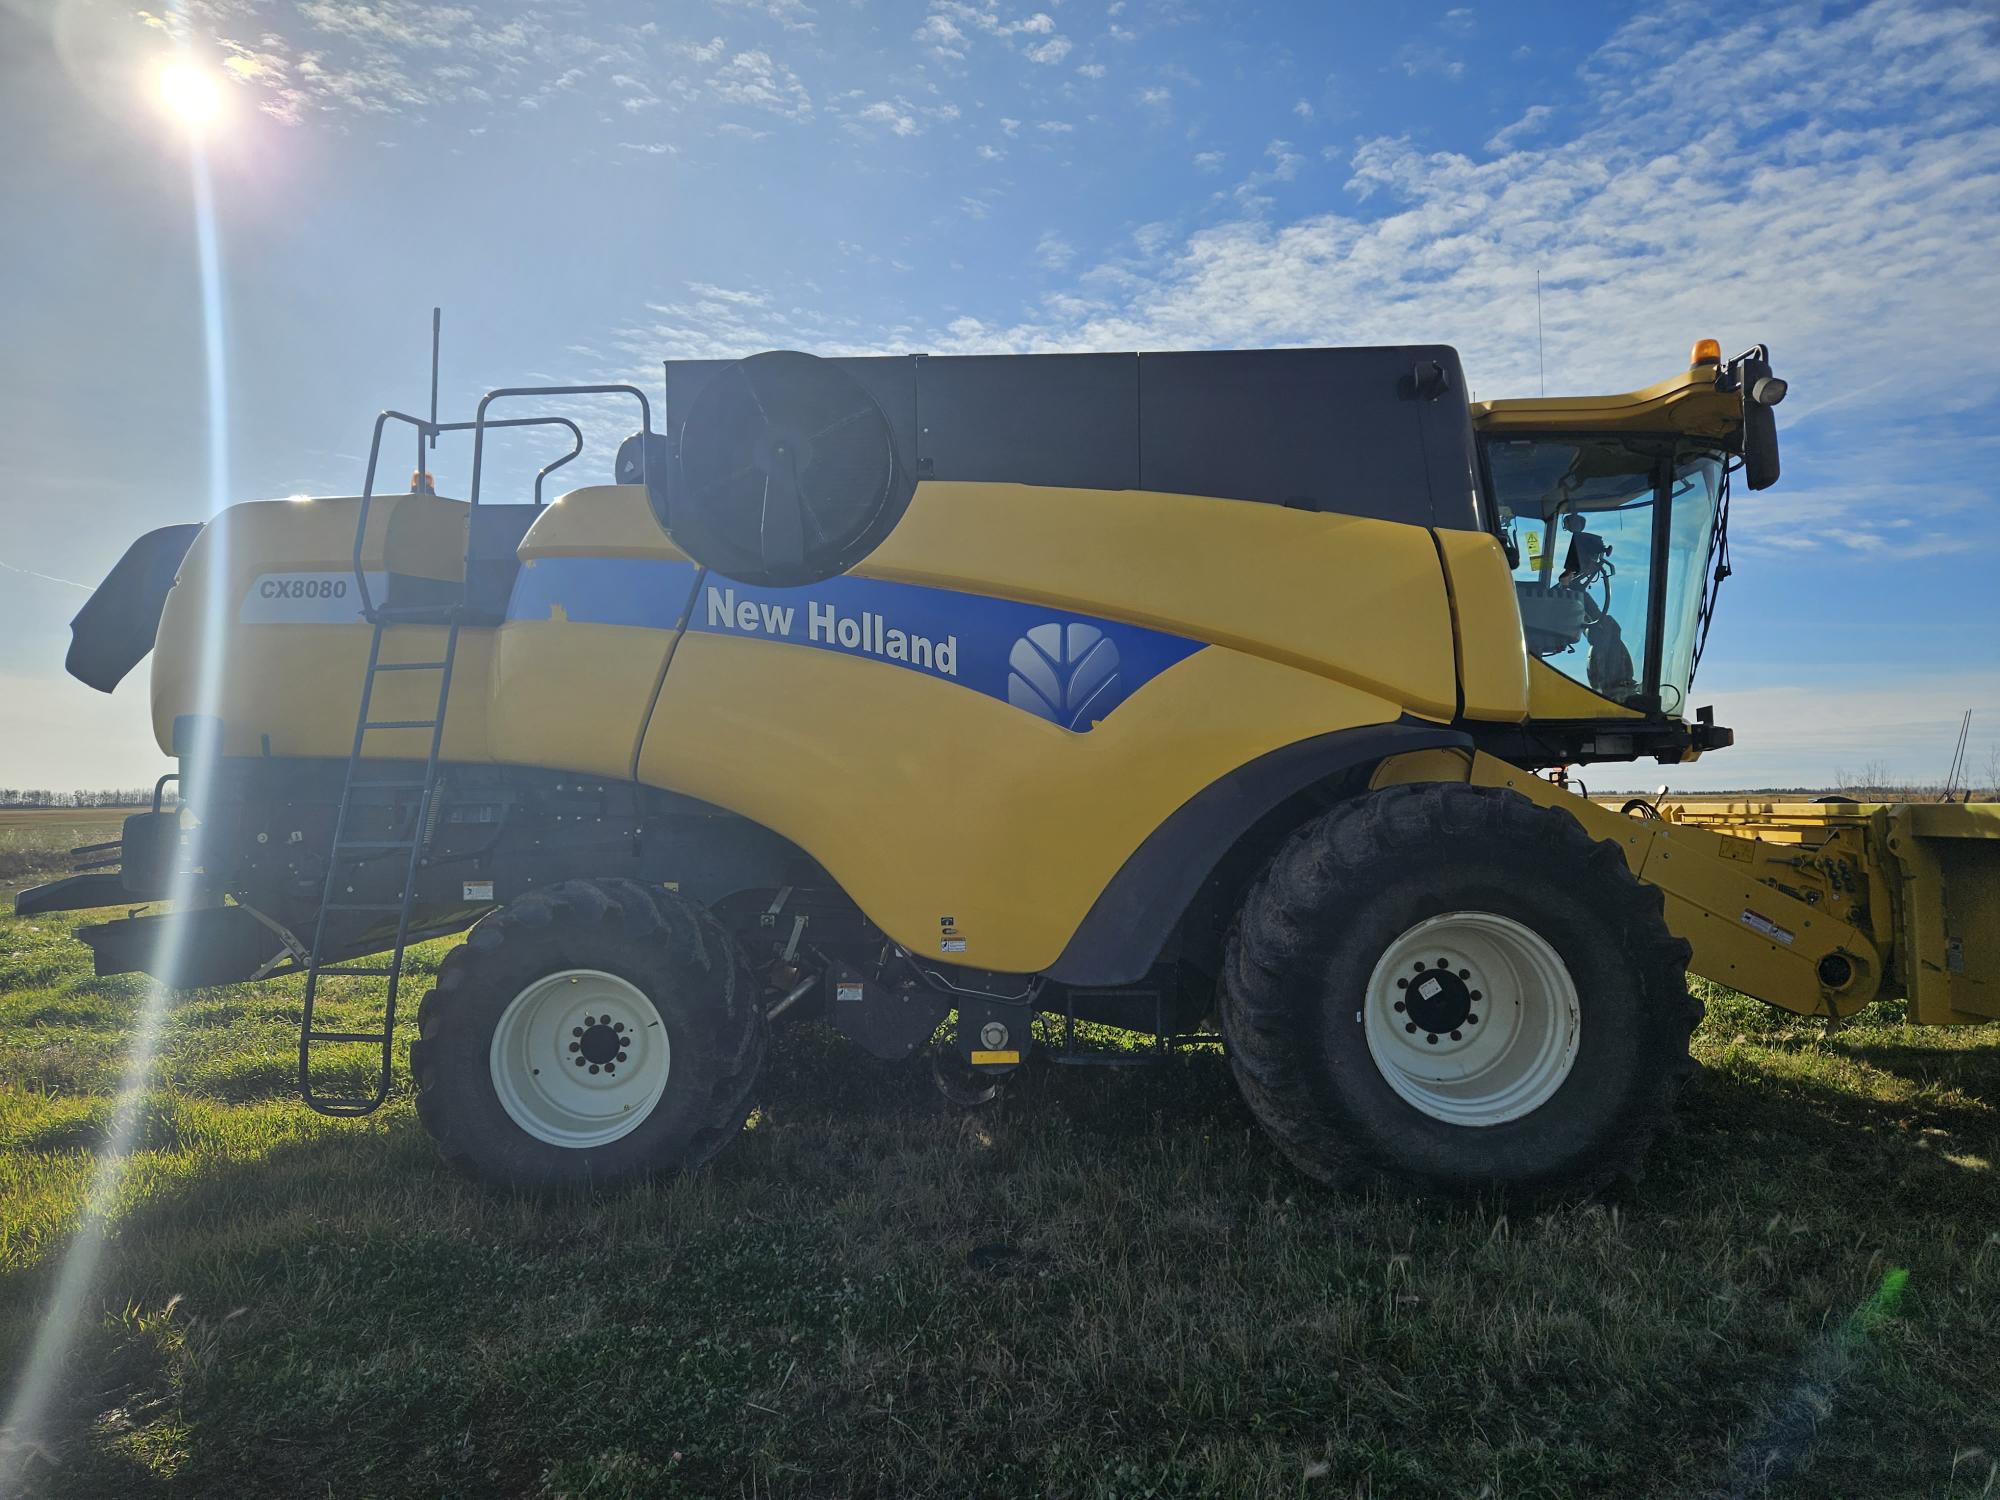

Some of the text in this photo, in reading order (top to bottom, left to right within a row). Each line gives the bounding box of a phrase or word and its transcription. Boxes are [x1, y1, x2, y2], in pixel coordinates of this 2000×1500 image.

[260, 580, 347, 599] CX8080
[706, 586, 957, 676] New Holland
